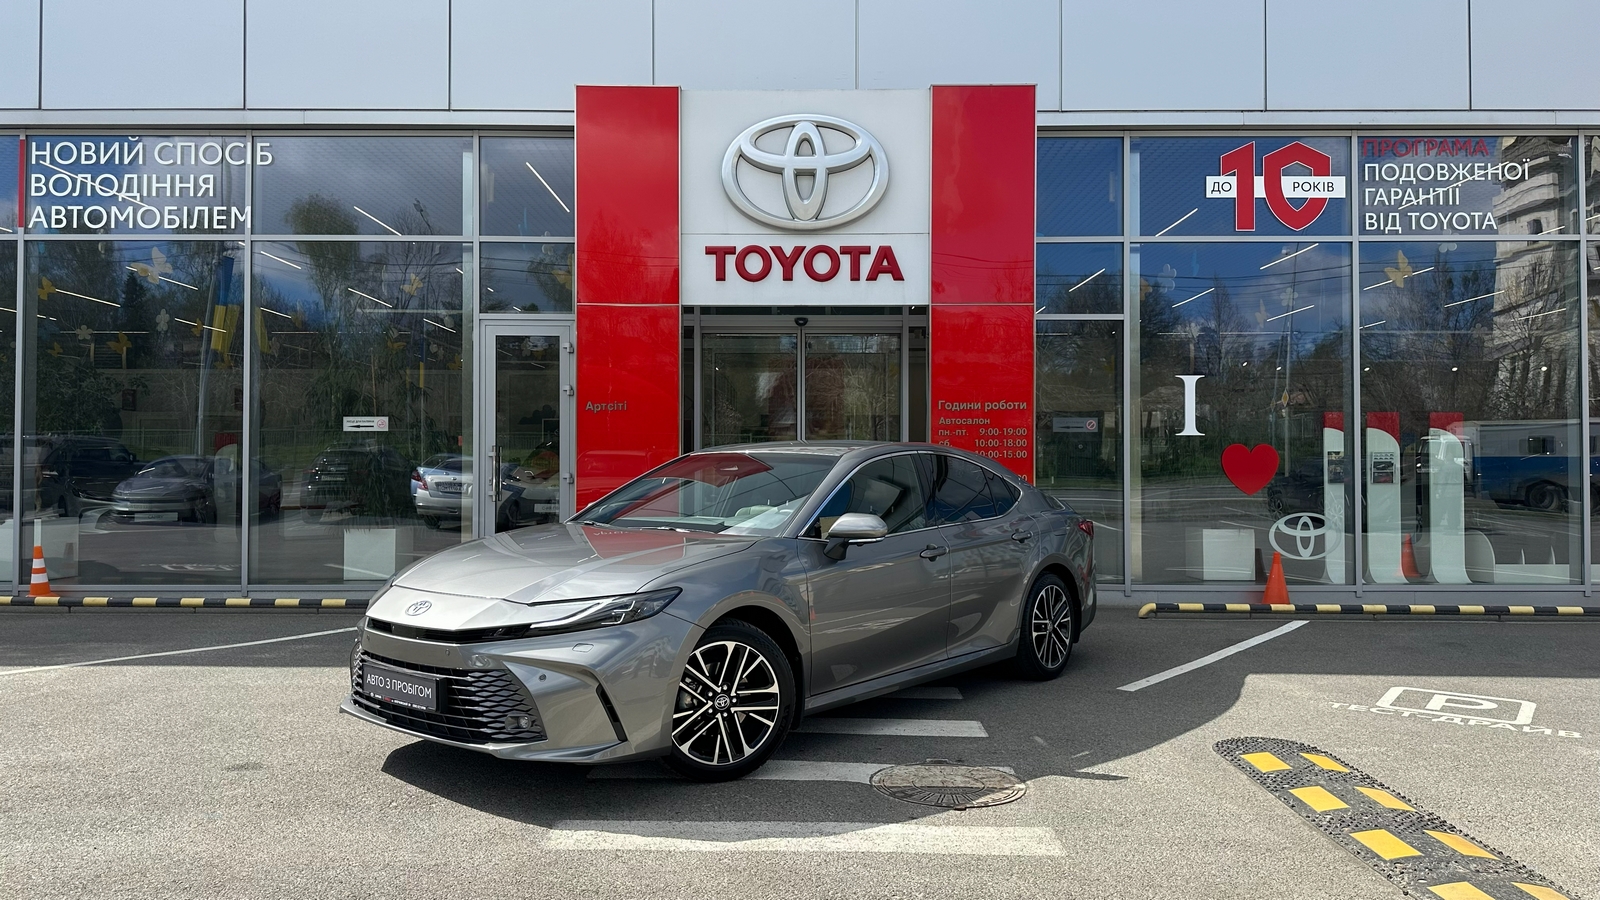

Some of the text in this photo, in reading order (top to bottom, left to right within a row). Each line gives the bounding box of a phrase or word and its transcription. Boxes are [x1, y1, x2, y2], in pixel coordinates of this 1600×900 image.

[31, 136, 273, 166] НОВИЙ СПОСІБ
[1362, 138, 1489, 157] ПРОГРАМА
[1364, 158, 1530, 184] ПОДОВЖЕНОЇ
[30, 173, 214, 201] ВОЛОДІННЯ
[1211, 141, 1335, 231] ДО 10 РОКІВ
[1365, 183, 1461, 206] ГАРАНТІЇ
[28, 205, 252, 229] АВТОМОБІЛЕМ
[1365, 212, 1498, 234] ВІД TOYOTA
[705, 244, 905, 282] TOYOTA
[585, 400, 627, 413] Артсіті
[938, 400, 1028, 412] Години роботи
[1174, 374, 1206, 436] I
[938, 416, 991, 425] Автосалон
[979, 427, 1028, 436] 9:00-19:00
[974, 439, 1028, 447] 10:00-18:00
[366, 673, 385, 688] АВТО
[391, 679, 432, 699] ПРОБІГОМ
